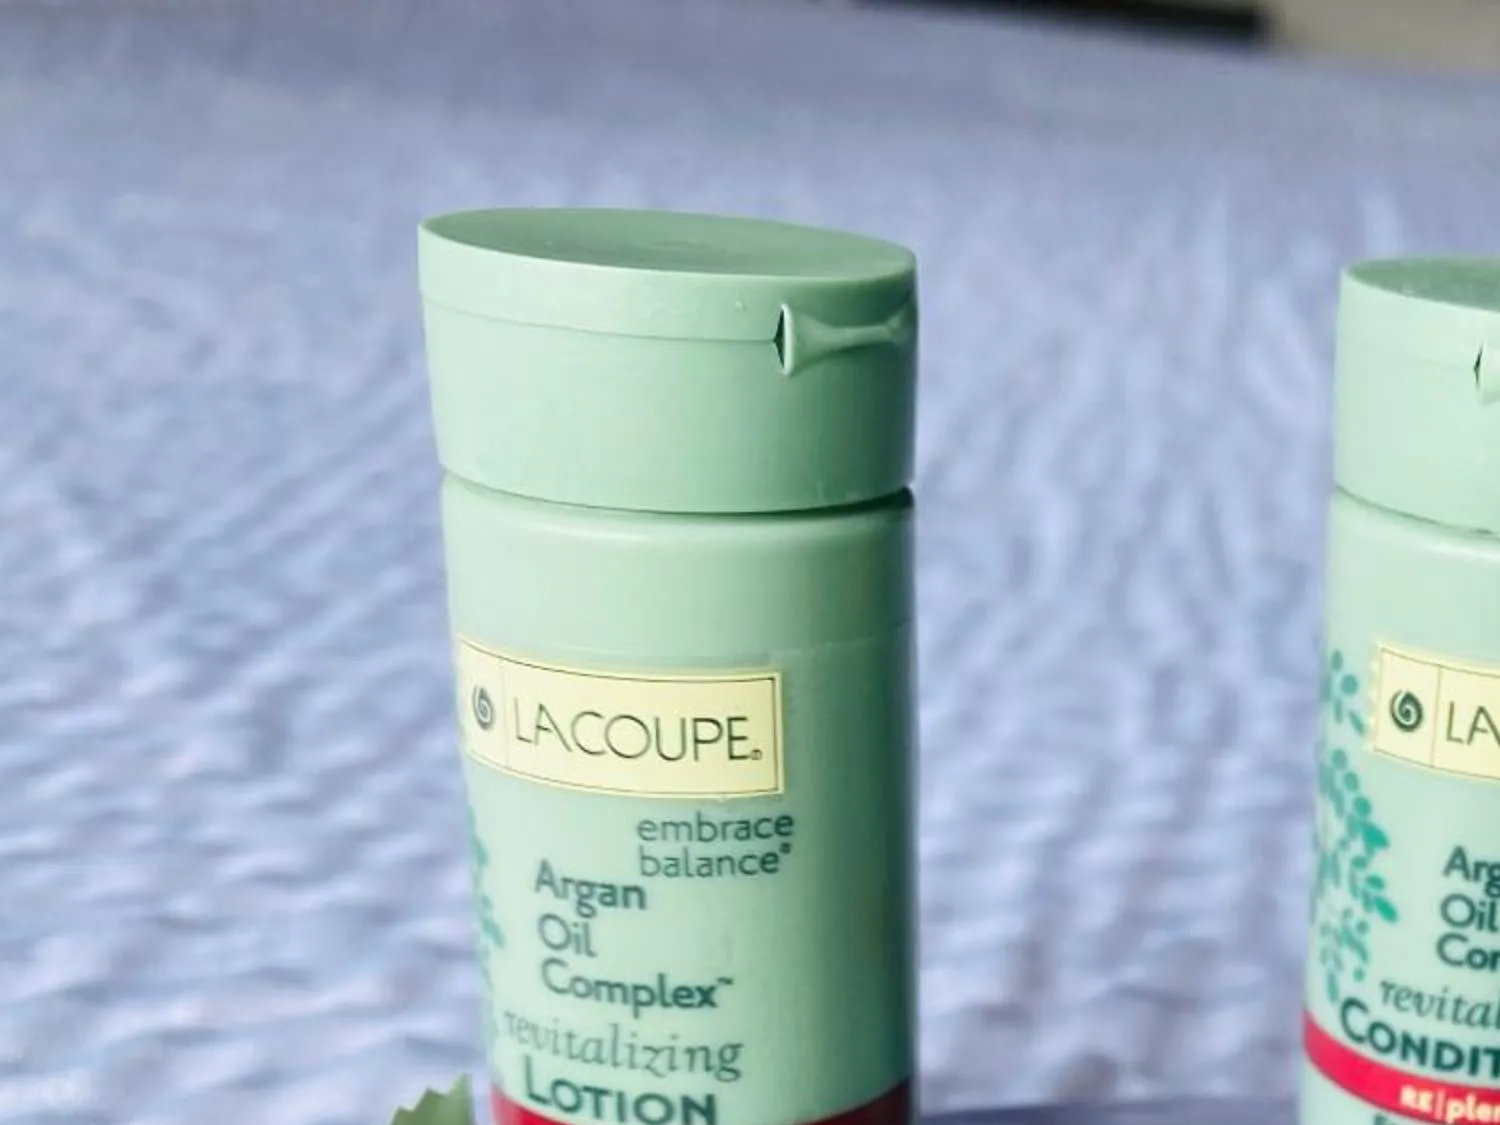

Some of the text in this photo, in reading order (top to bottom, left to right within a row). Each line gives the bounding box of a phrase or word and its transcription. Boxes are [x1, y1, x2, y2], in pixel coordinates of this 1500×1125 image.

[636, 812, 794, 843] embrace
[534, 860, 647, 918] Argan
[1440, 893, 1499, 933] Oil
[538, 914, 597, 957] Oil
[504, 1010, 744, 1081] revitalizing
